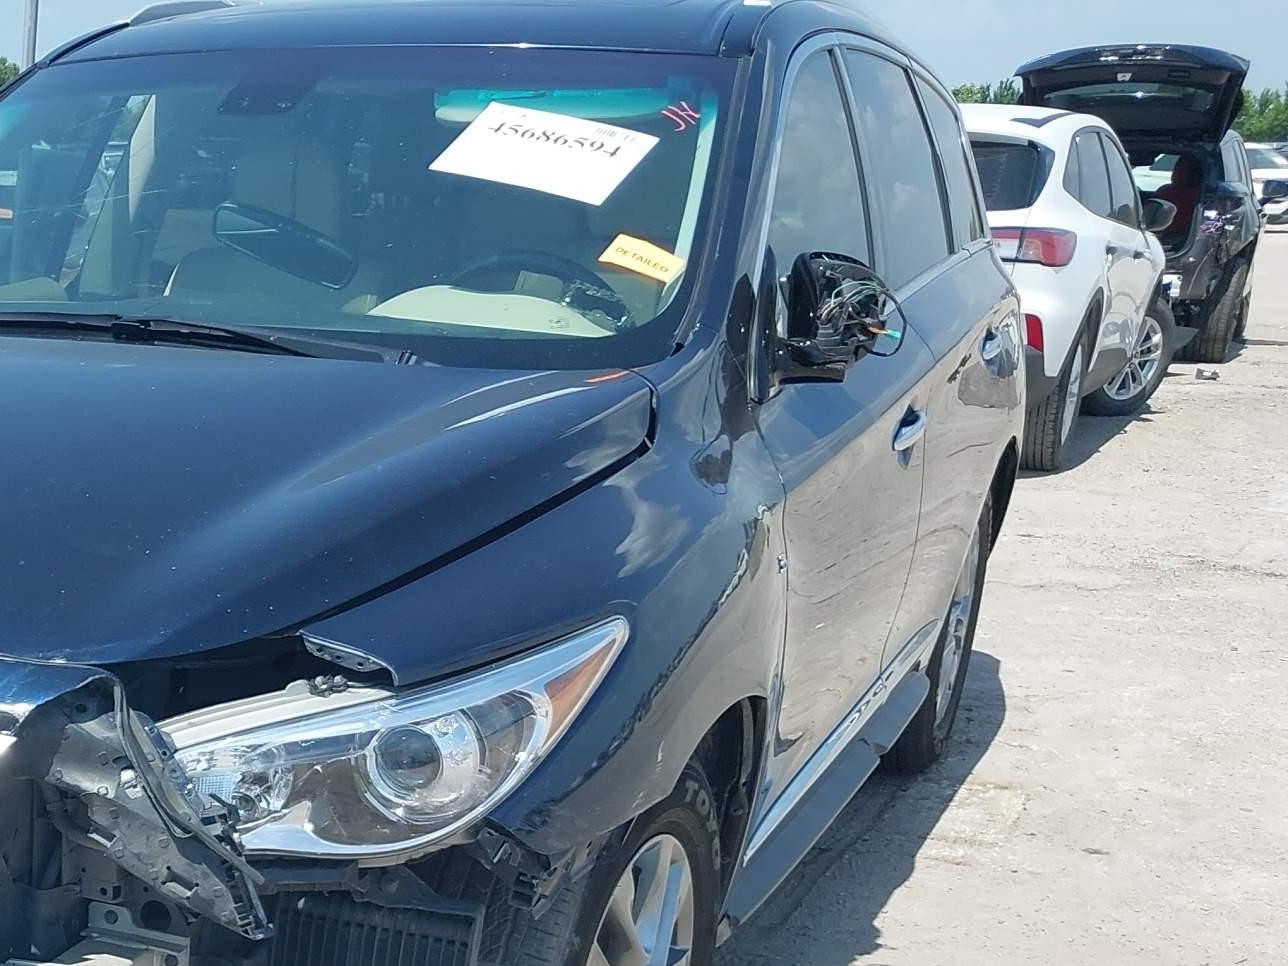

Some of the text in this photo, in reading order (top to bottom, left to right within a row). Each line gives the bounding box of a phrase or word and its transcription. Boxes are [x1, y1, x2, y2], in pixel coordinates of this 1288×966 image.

[488, 122, 621, 157] 45686594
[615, 246, 669, 273] DETAILED
[684, 780, 721, 870] TOYO
